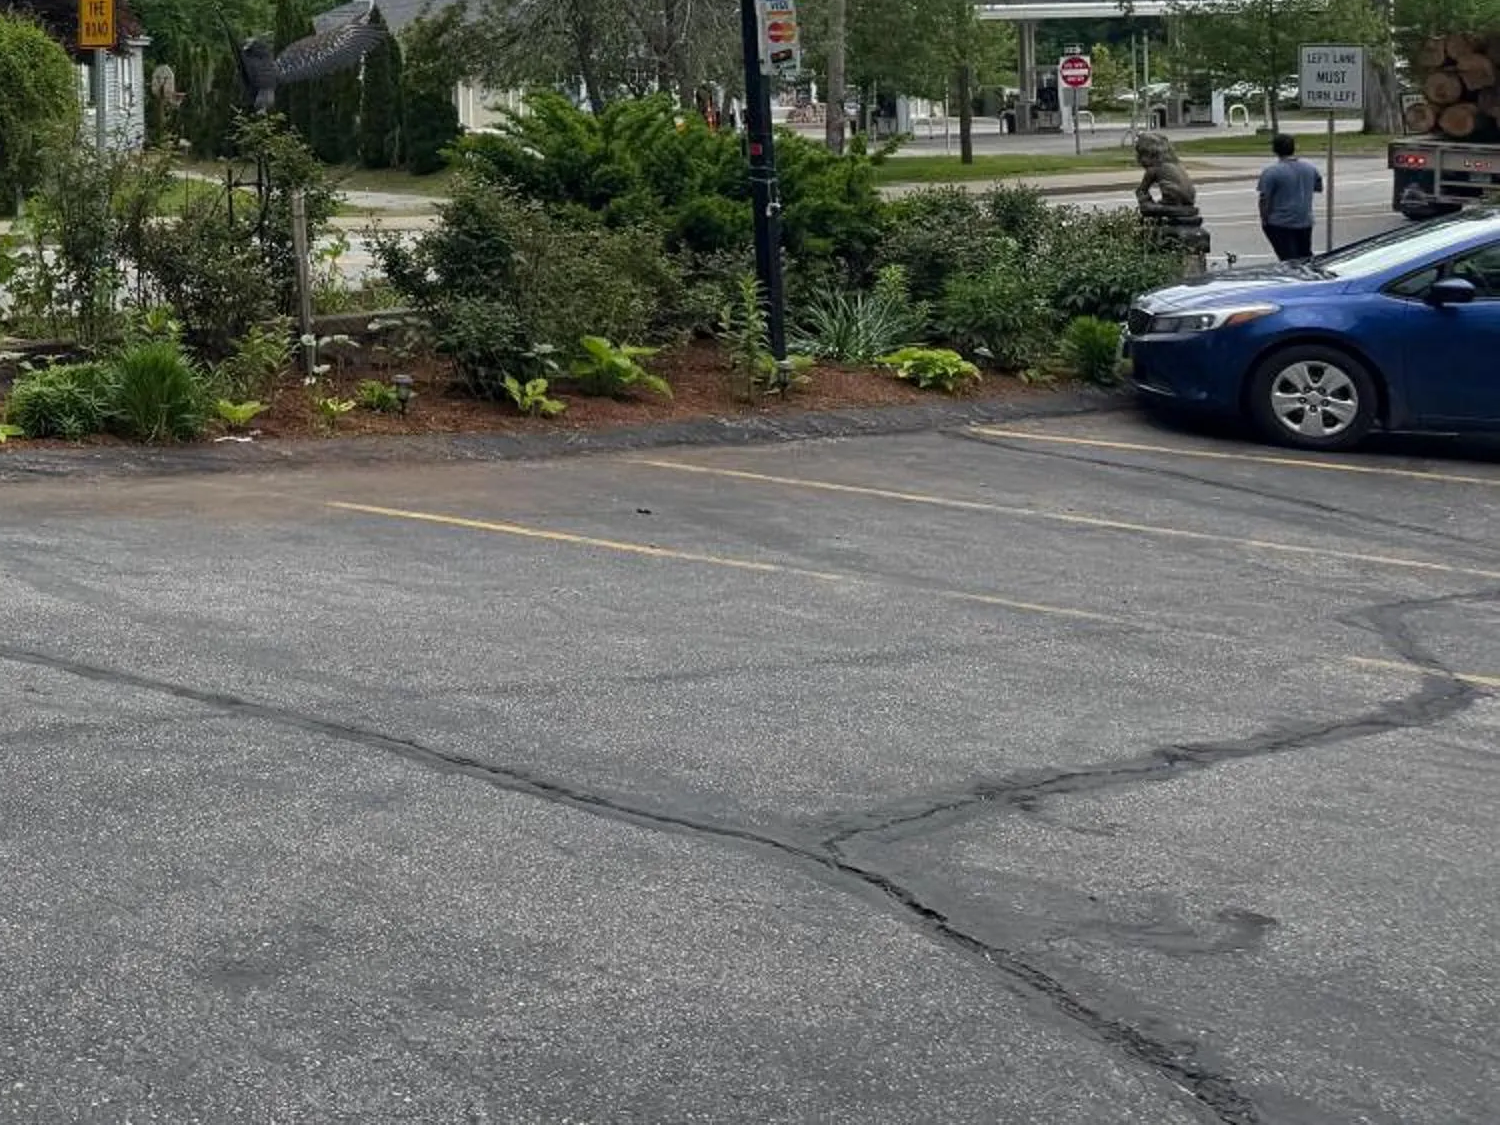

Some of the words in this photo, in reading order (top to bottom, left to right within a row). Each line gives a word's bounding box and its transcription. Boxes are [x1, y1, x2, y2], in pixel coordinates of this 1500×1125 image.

[1307, 53, 1329, 64] LEFT
[1317, 71, 1347, 84] MUST
[1333, 91, 1357, 103] LEFT
